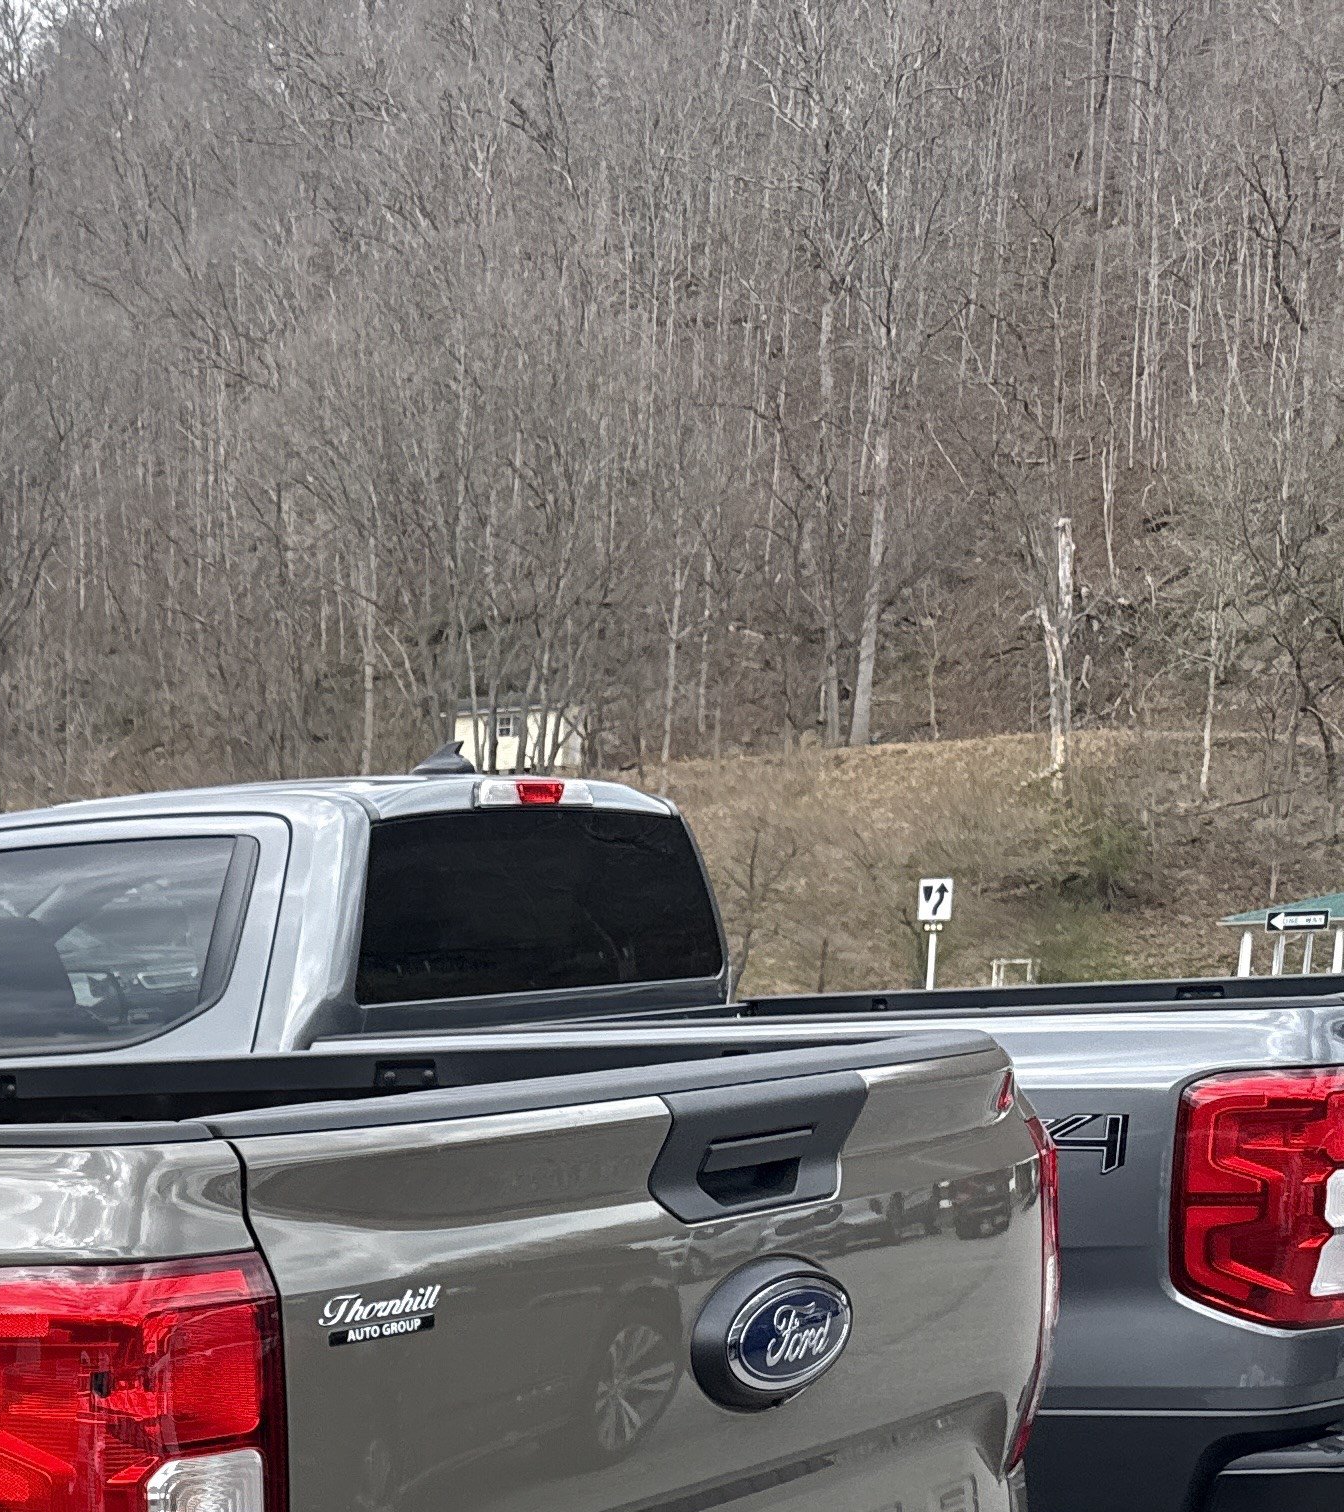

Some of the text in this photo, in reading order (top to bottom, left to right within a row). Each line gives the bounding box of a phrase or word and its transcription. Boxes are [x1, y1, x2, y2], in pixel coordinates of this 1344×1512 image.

[318, 1284, 441, 1326] Thornhill
[346, 1318, 422, 1342] AUTO GROUP
[765, 1301, 833, 1367] Ford
